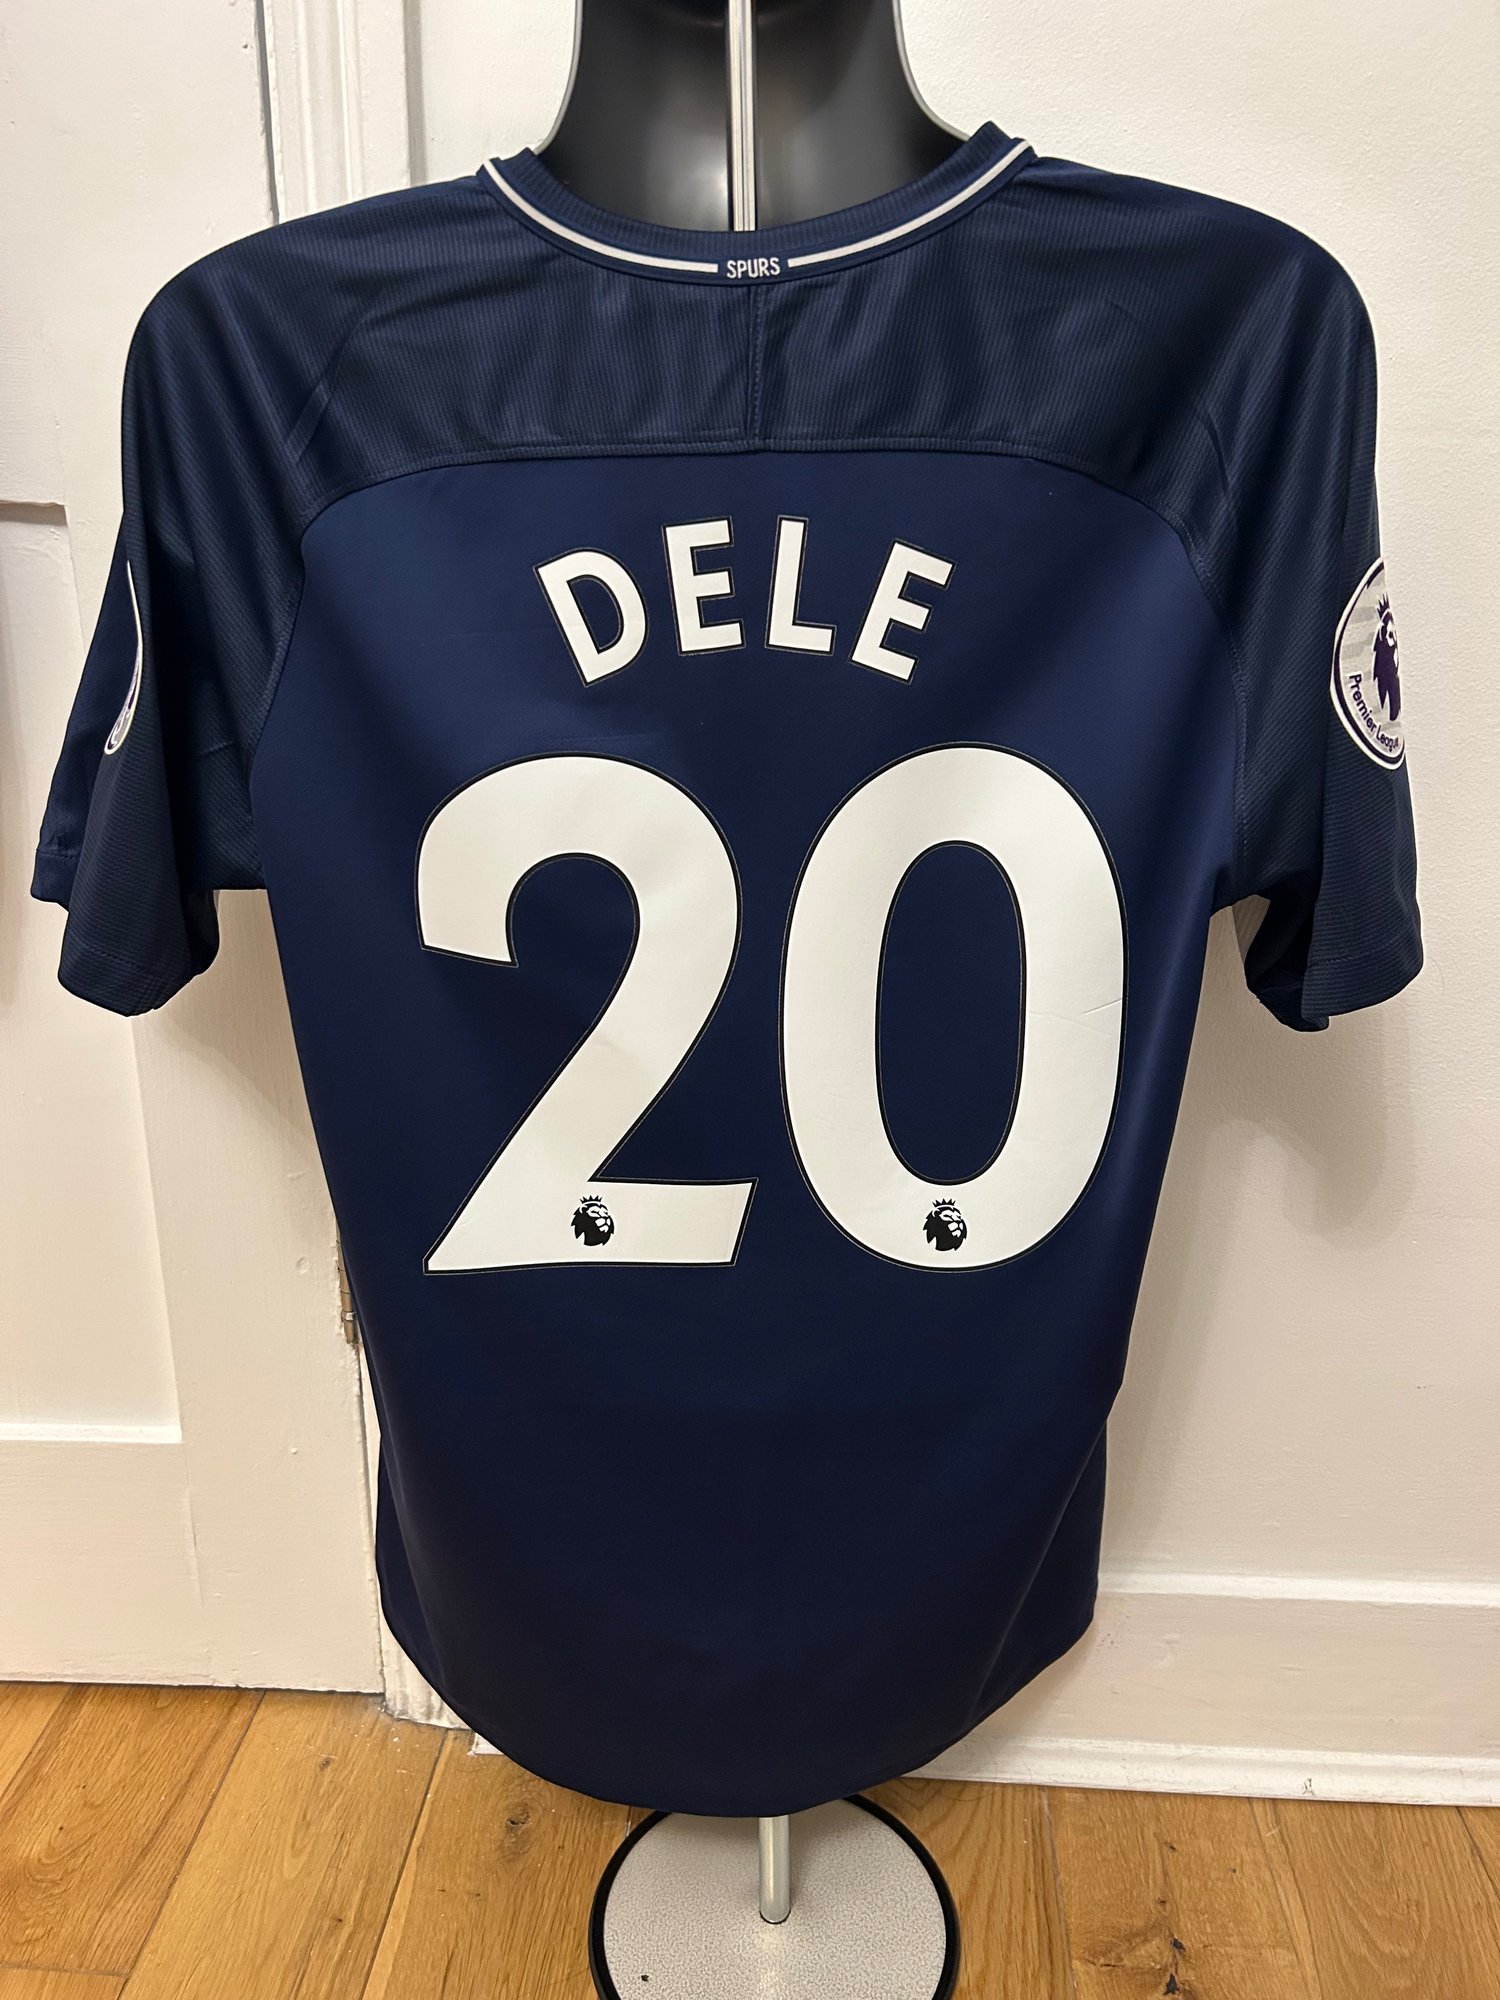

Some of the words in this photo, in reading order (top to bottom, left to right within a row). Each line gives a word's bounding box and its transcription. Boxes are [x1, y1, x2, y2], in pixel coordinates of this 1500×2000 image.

[726, 257, 781, 279] SPURS
[534, 515, 956, 687] DELE
[1348, 673, 1378, 732] Premier
[415, 741, 1128, 1273] 20
